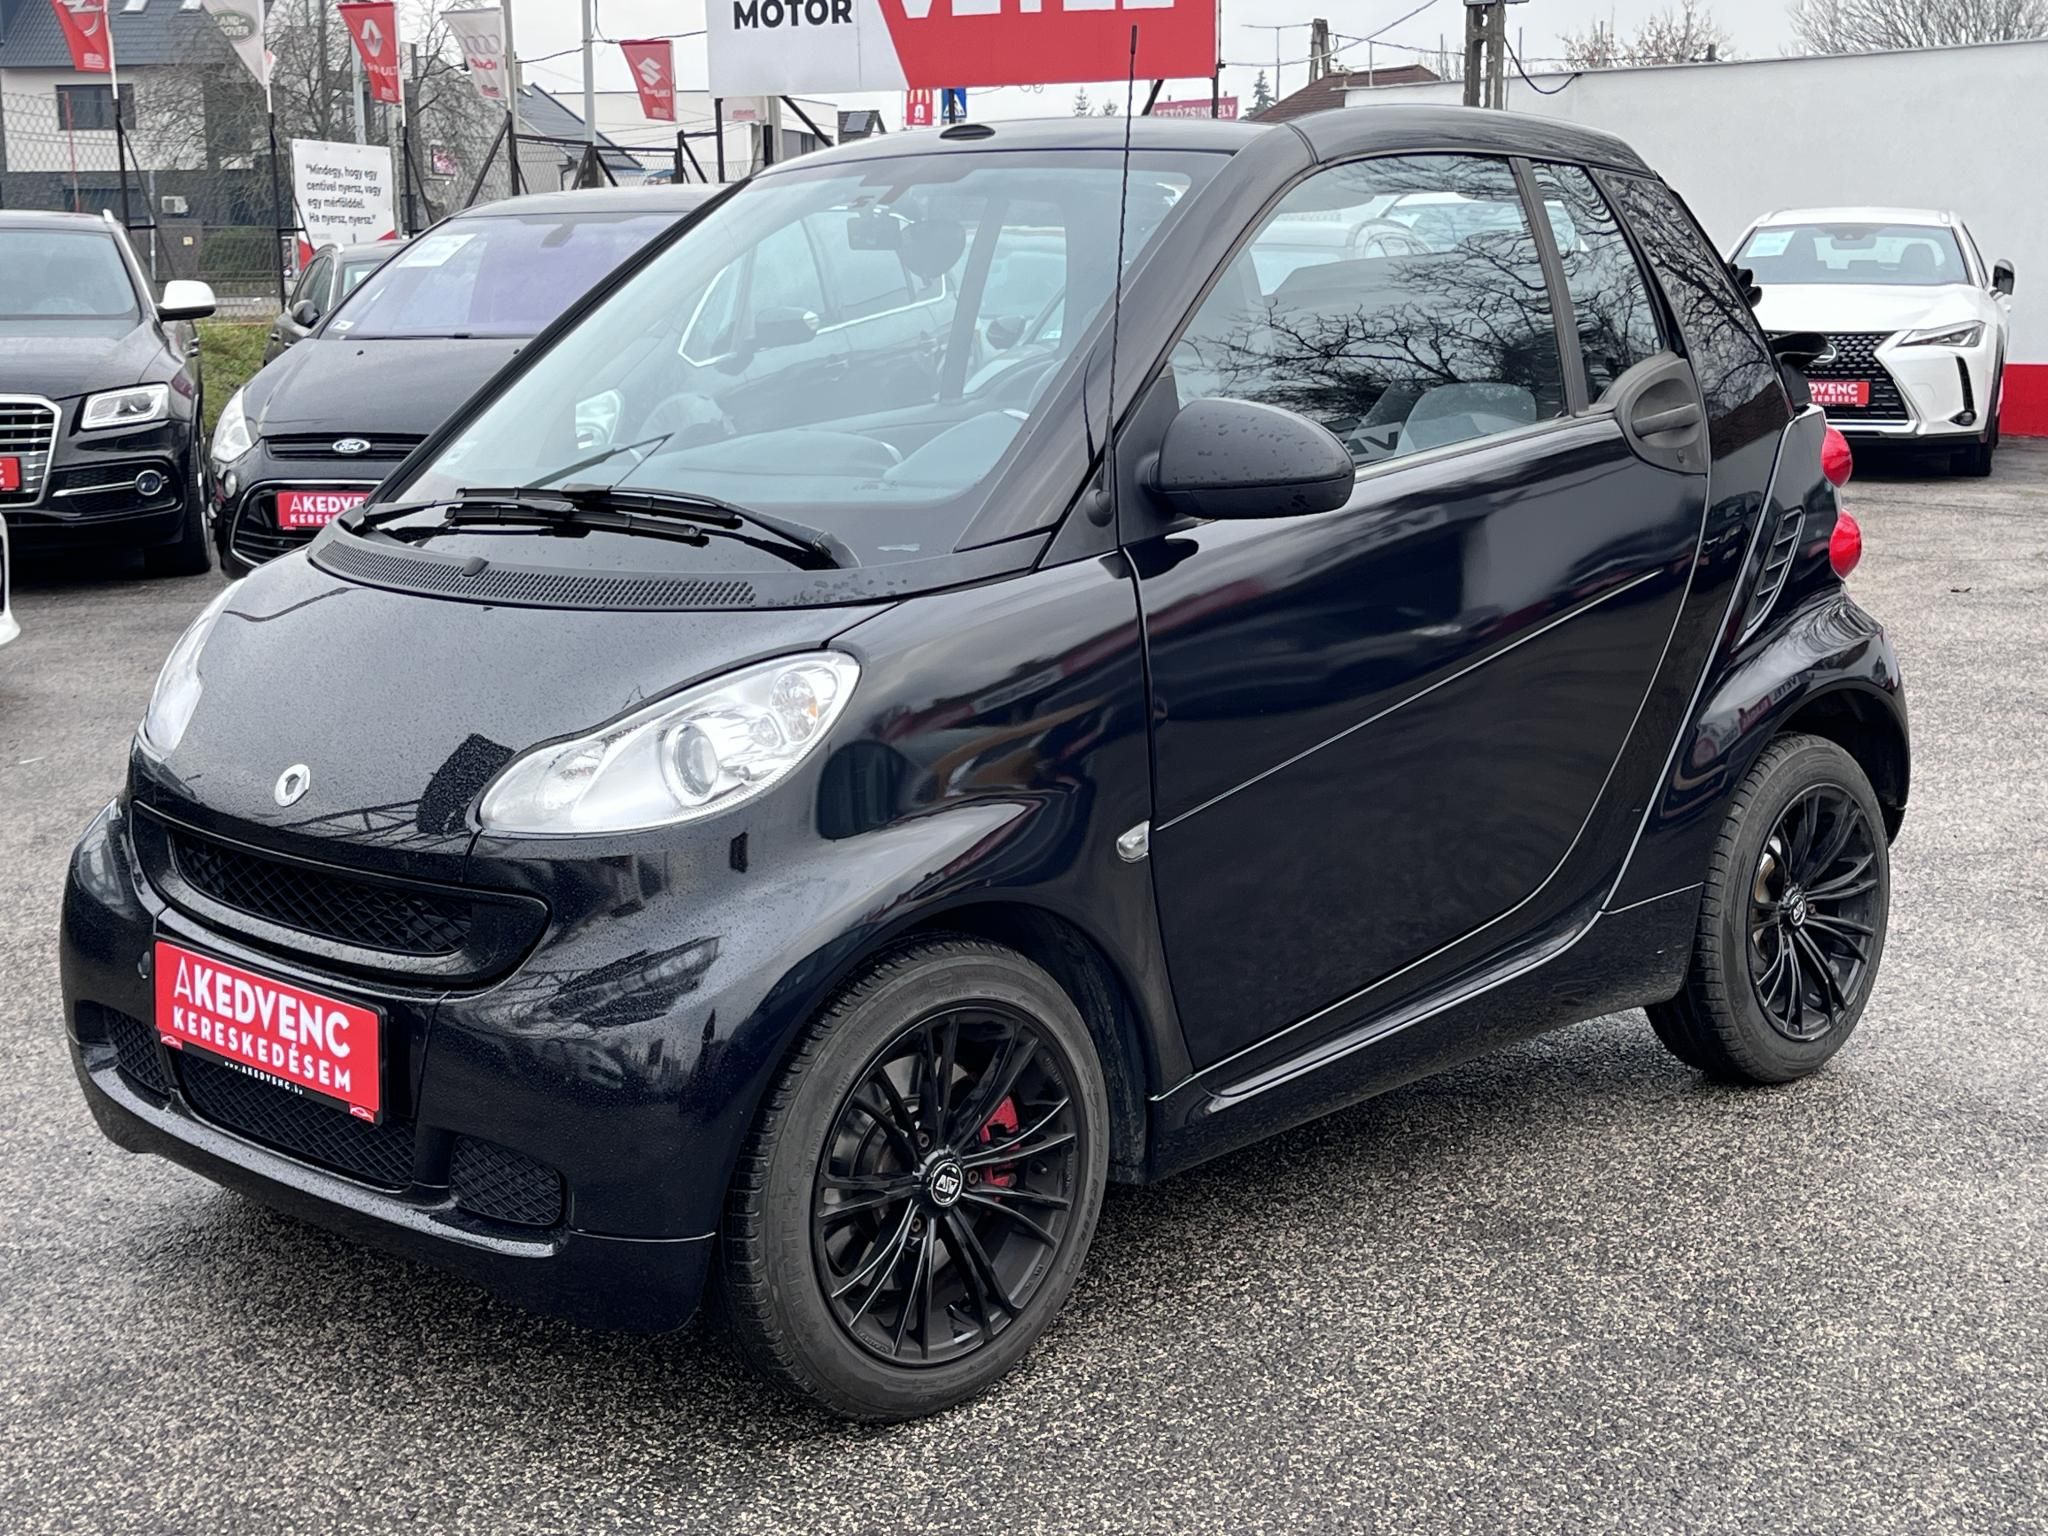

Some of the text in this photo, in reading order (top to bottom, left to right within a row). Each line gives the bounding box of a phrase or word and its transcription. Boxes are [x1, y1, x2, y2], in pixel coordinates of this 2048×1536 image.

[733, 0, 852, 29] MOTOR
[345, 166, 362, 180] hogy
[364, 170, 378, 181] egy
[306, 180, 336, 191] centivel
[365, 186, 382, 197] vagy
[307, 198, 322, 209] egy
[309, 212, 320, 223] Ha
[173, 956, 351, 1058] AKEDVENC
[173, 1005, 351, 1093] KERESKEDÉSEM
